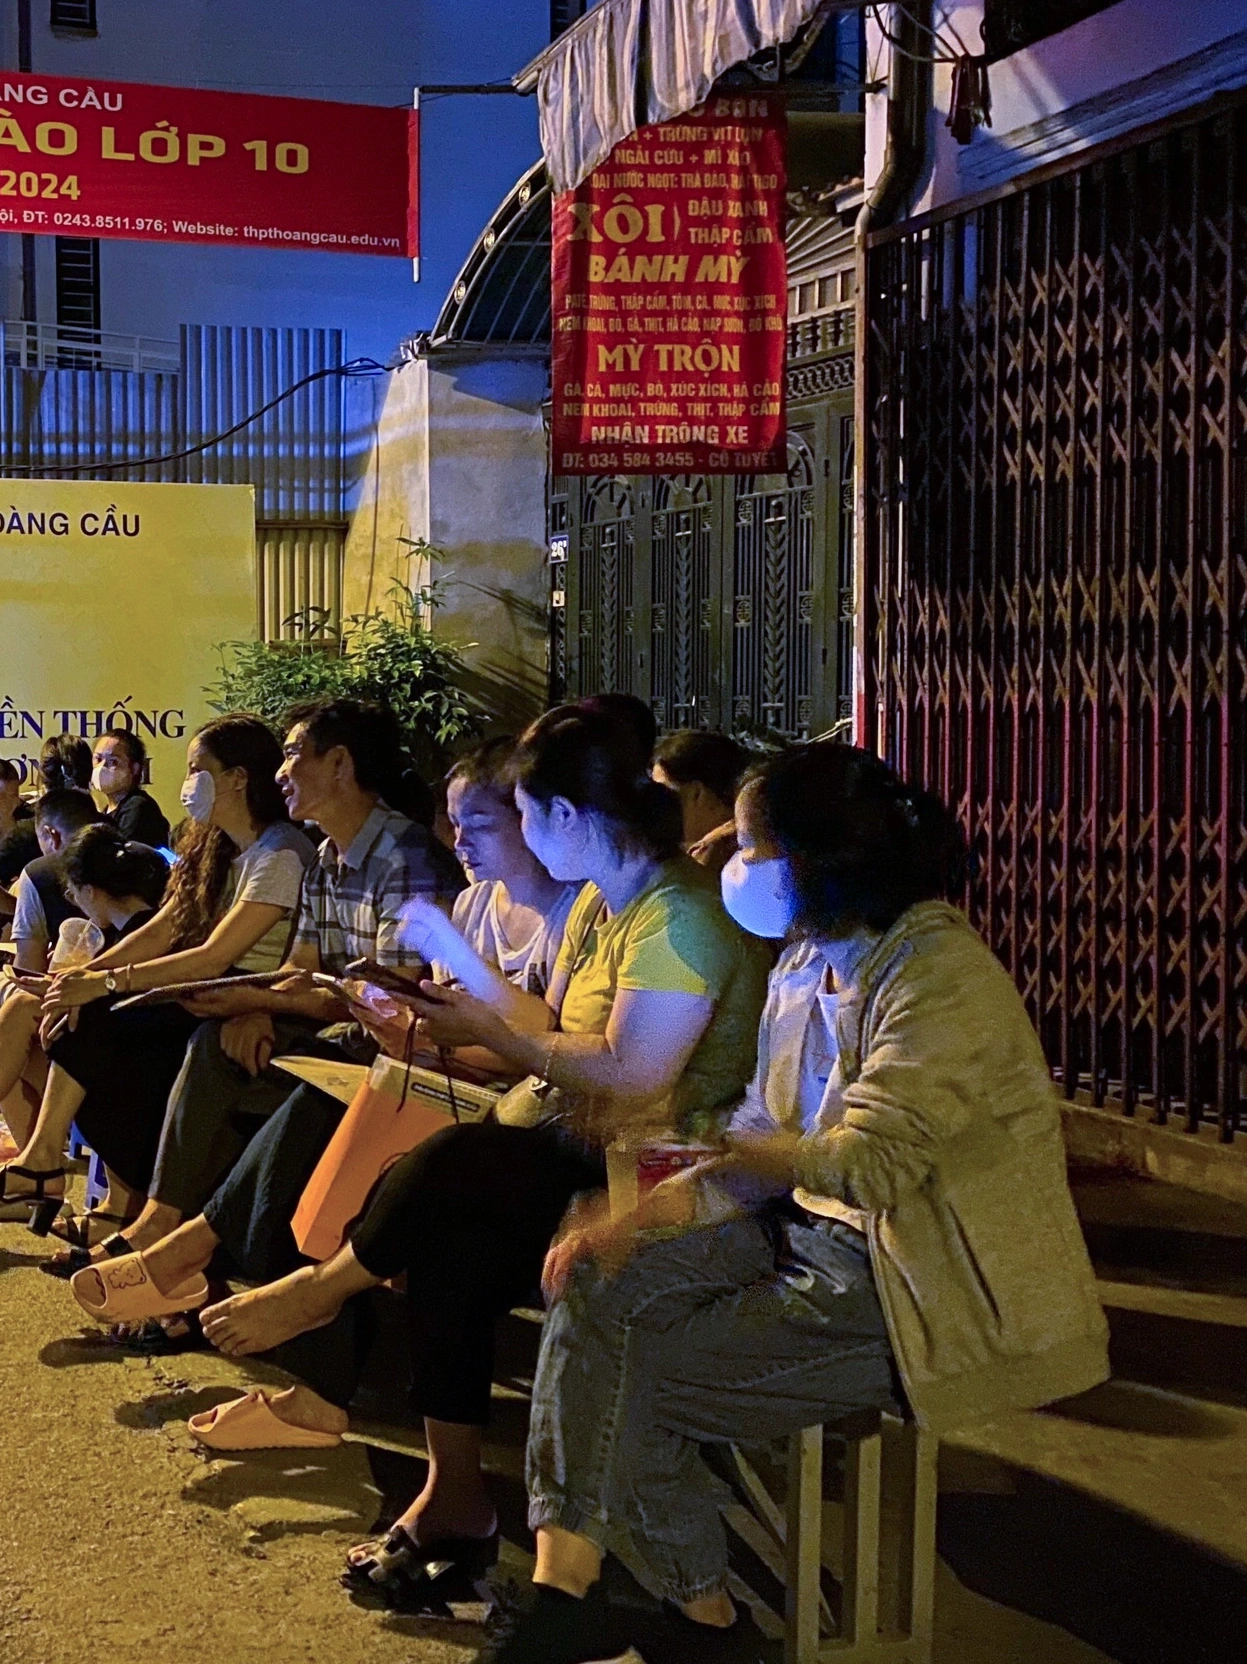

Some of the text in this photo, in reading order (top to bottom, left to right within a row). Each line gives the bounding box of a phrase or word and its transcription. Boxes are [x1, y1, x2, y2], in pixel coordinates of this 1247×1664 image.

[58, 86, 123, 111] CẦU
[101, 120, 226, 166] LỚP
[242, 139, 309, 174] 10
[592, 173, 610, 192] OẠI
[567, 193, 666, 243] XÔI
[688, 194, 768, 220] ĐẬU XANH
[22, 211, 49, 225] ĐT:
[54, 212, 168, 235] 0243.8511.976;
[172, 219, 239, 238] Website:
[243, 225, 400, 248] thpthoangcau.edu.vn
[688, 224, 731, 248] THẬP
[588, 247, 689, 284] BÁNH
[598, 338, 740, 378] MỲ TRỘN
[591, 421, 749, 448] NHẬN TRÔNG XE
[589, 452, 619, 467] 034
[623, 452, 650, 467] 584
[655, 452, 694, 467] 3455
[80, 503, 141, 538] CẦU
[53, 695, 187, 740] THỐNG
